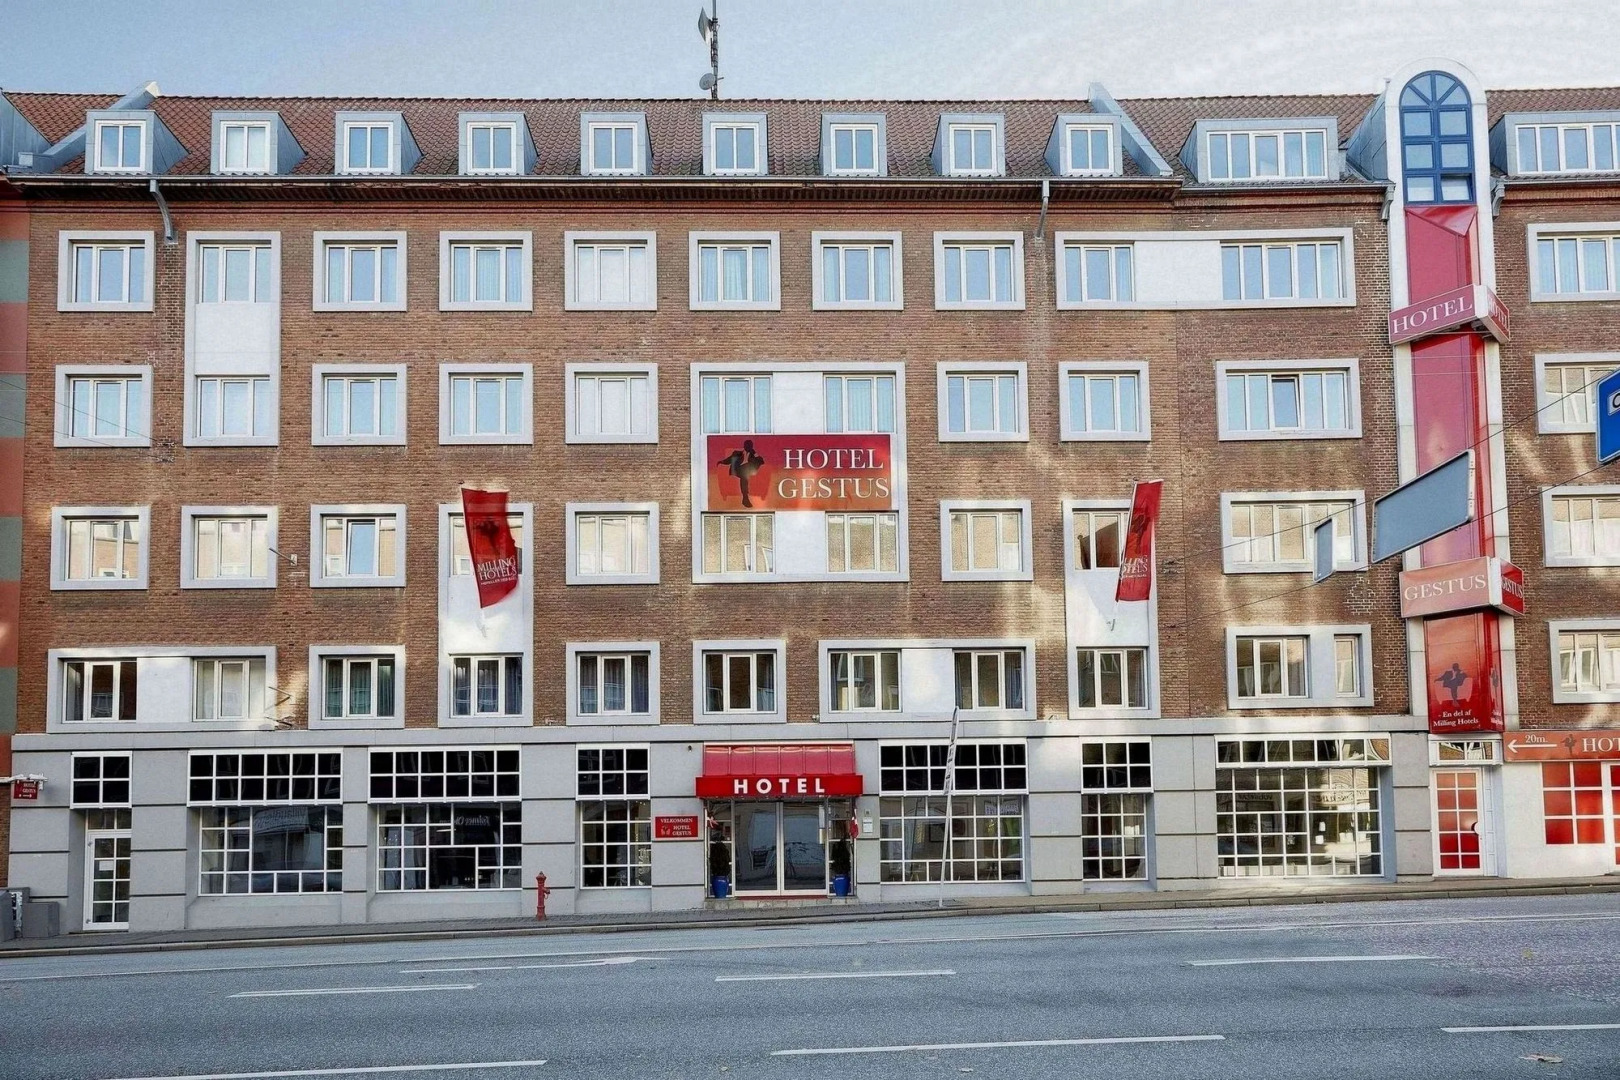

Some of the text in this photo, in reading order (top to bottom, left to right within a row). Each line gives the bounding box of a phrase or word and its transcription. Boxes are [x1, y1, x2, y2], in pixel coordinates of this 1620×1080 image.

[1392, 296, 1473, 334] HOTEL
[783, 448, 884, 470] HOTEL
[777, 477, 890, 499] GESTUS
[477, 556, 516, 572] MILLING
[479, 566, 517, 581] HOTELS
[1405, 575, 1486, 601] GESTUS
[1501, 574, 1523, 599] GESTUS
[1457, 717, 1479, 725] Hotels
[733, 778, 826, 794] HOTEL
